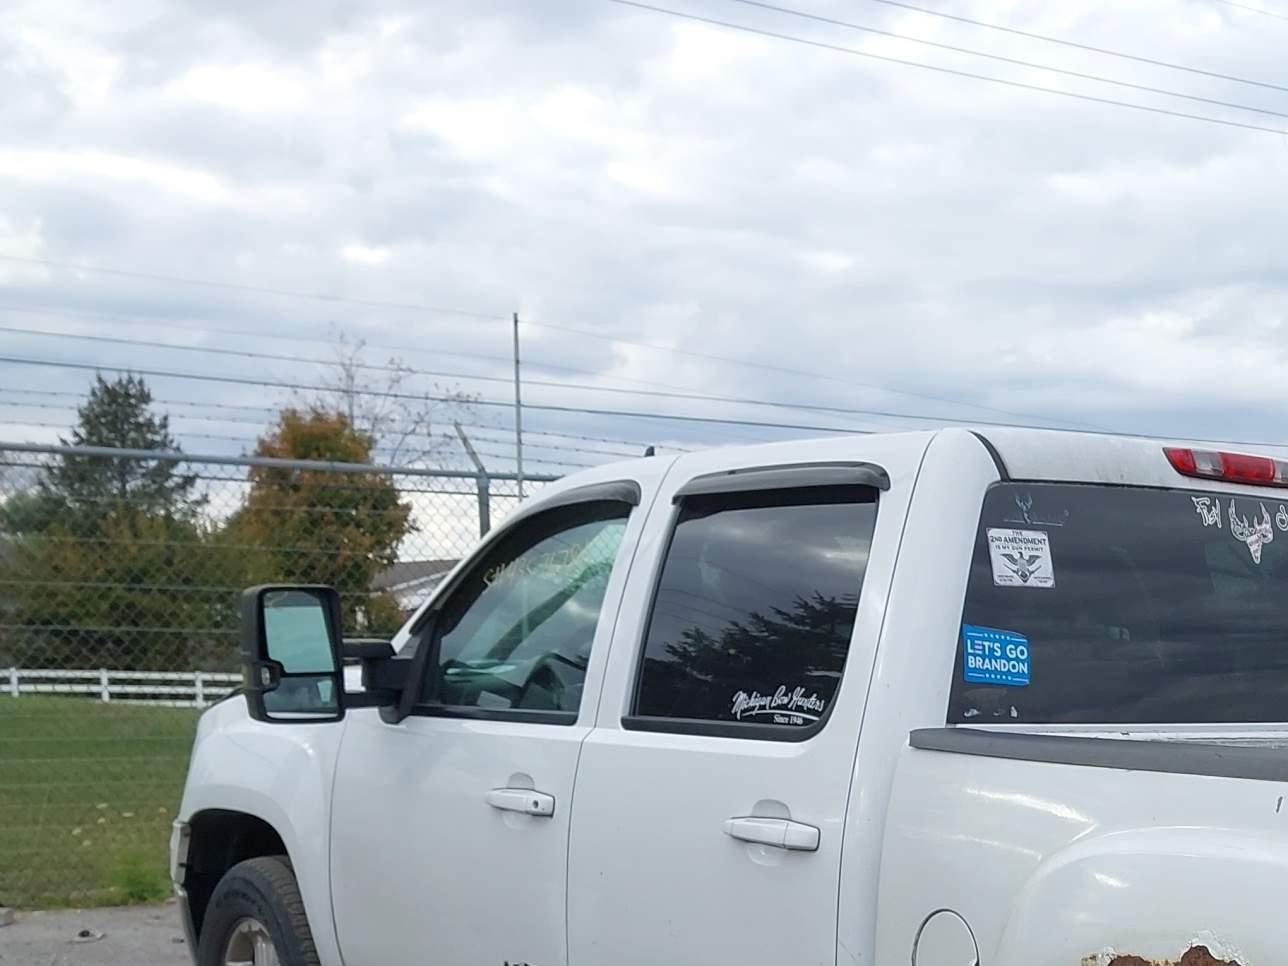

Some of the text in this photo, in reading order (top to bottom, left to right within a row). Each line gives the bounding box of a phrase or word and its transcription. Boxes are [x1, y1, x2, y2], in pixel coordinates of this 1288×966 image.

[1003, 536, 1047, 545] AMENDMENT
[967, 639, 1028, 660] LET'S GO
[968, 655, 1028, 674] BRANDON
[731, 690, 772, 720] Michigan
[774, 714, 804, 725] Since 1946
